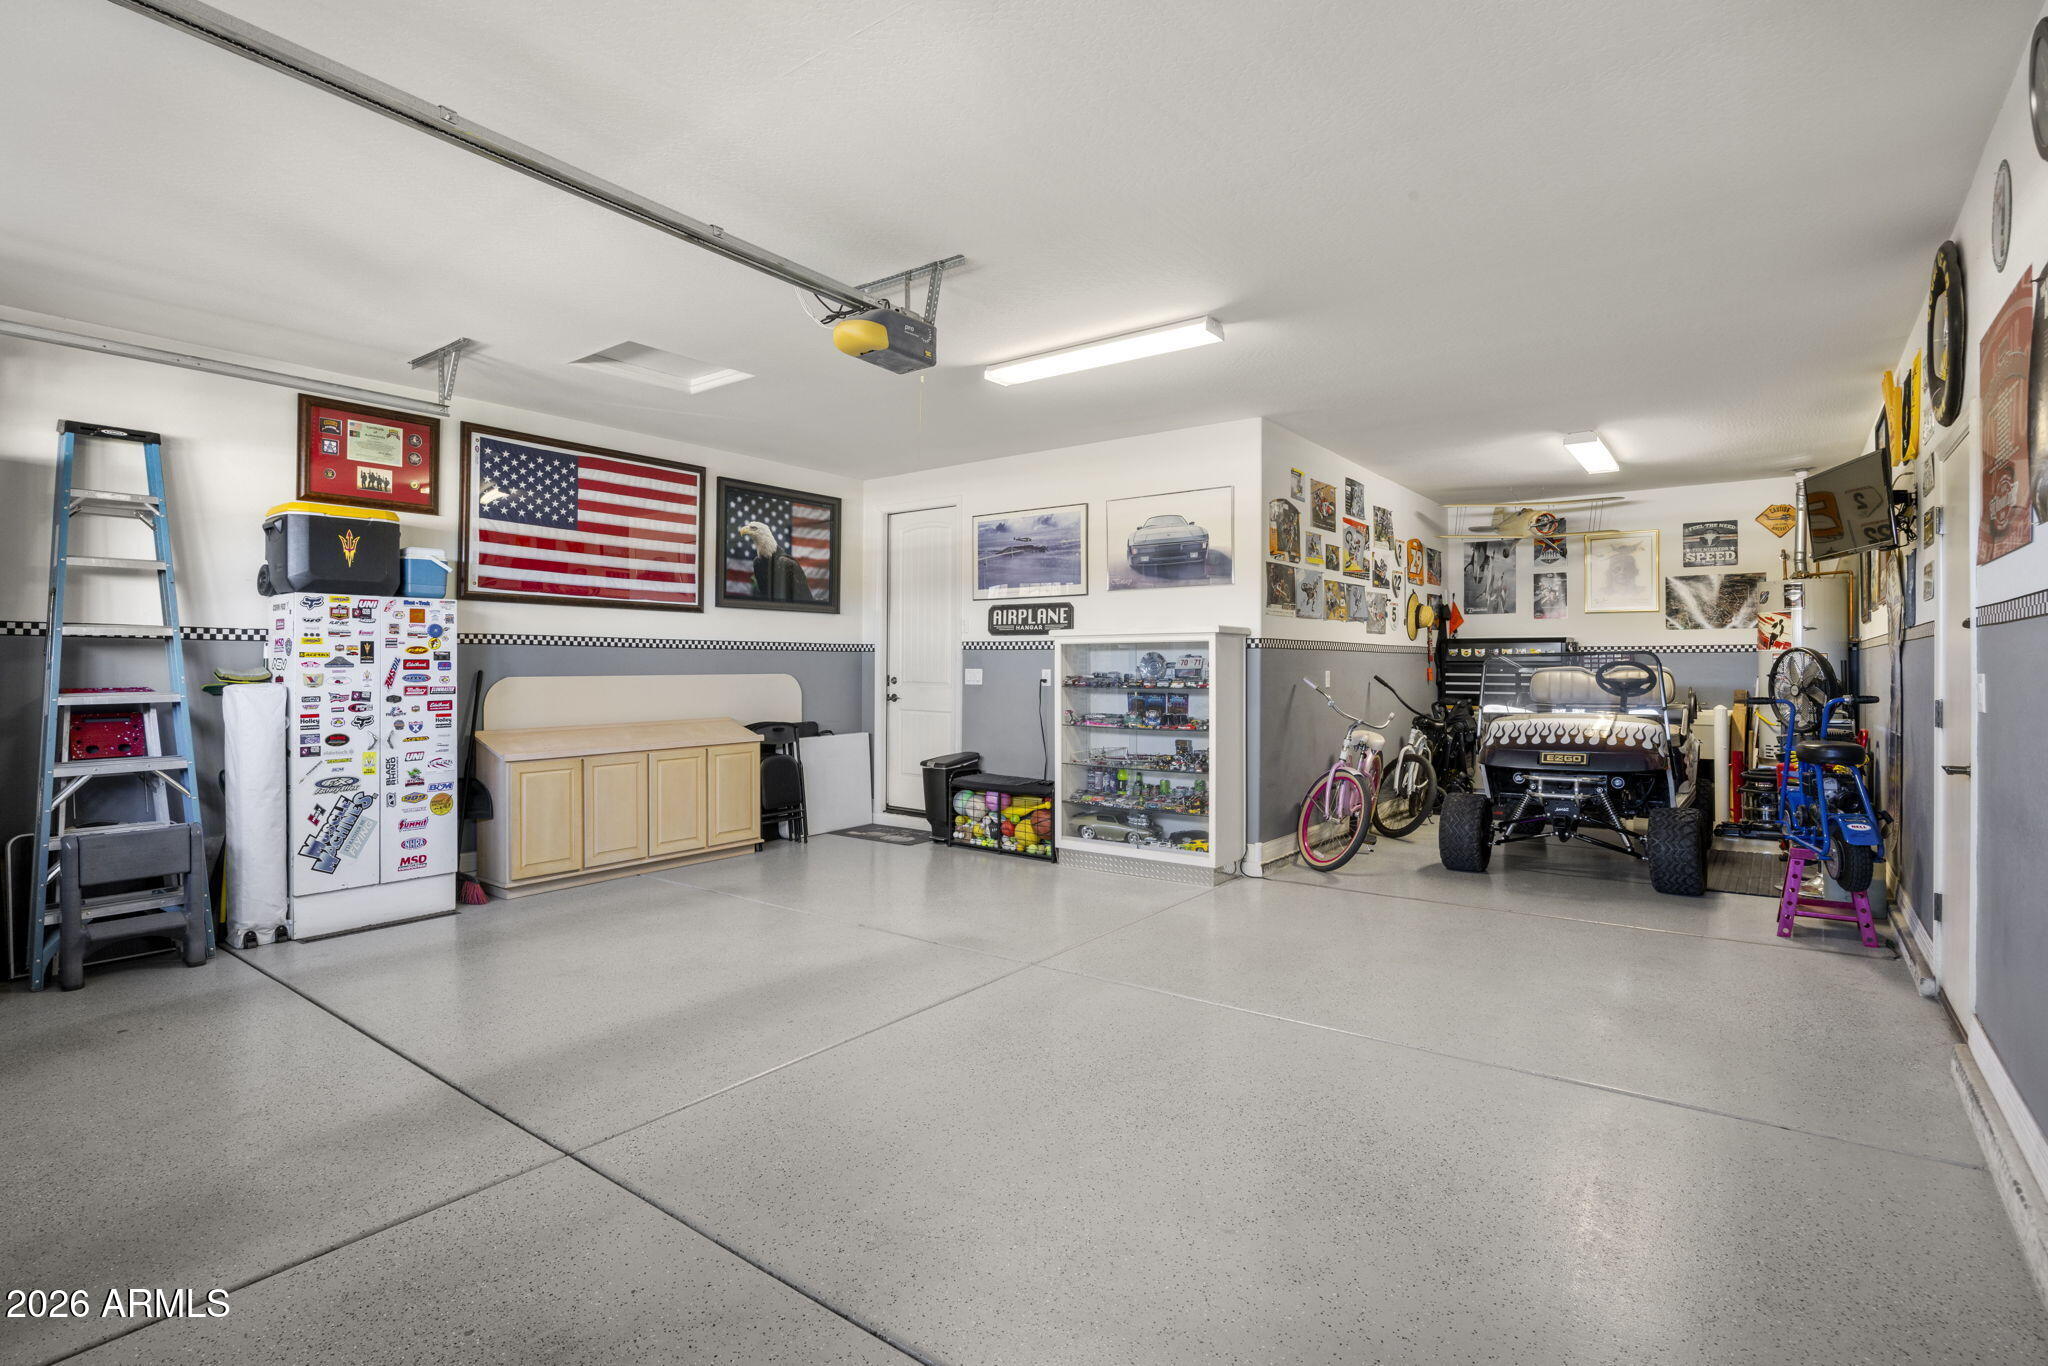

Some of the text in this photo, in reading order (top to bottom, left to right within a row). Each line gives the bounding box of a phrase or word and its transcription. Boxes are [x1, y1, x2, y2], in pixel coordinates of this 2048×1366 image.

[1686, 551, 1736, 563] SPEED
[359, 600, 378, 609] UNI
[993, 607, 1069, 625] AIRPLANE
[406, 752, 424, 761] UNI
[297, 794, 352, 859] MUSCLE
[310, 791, 372, 874] MACHINES
[400, 855, 427, 866] MSD
